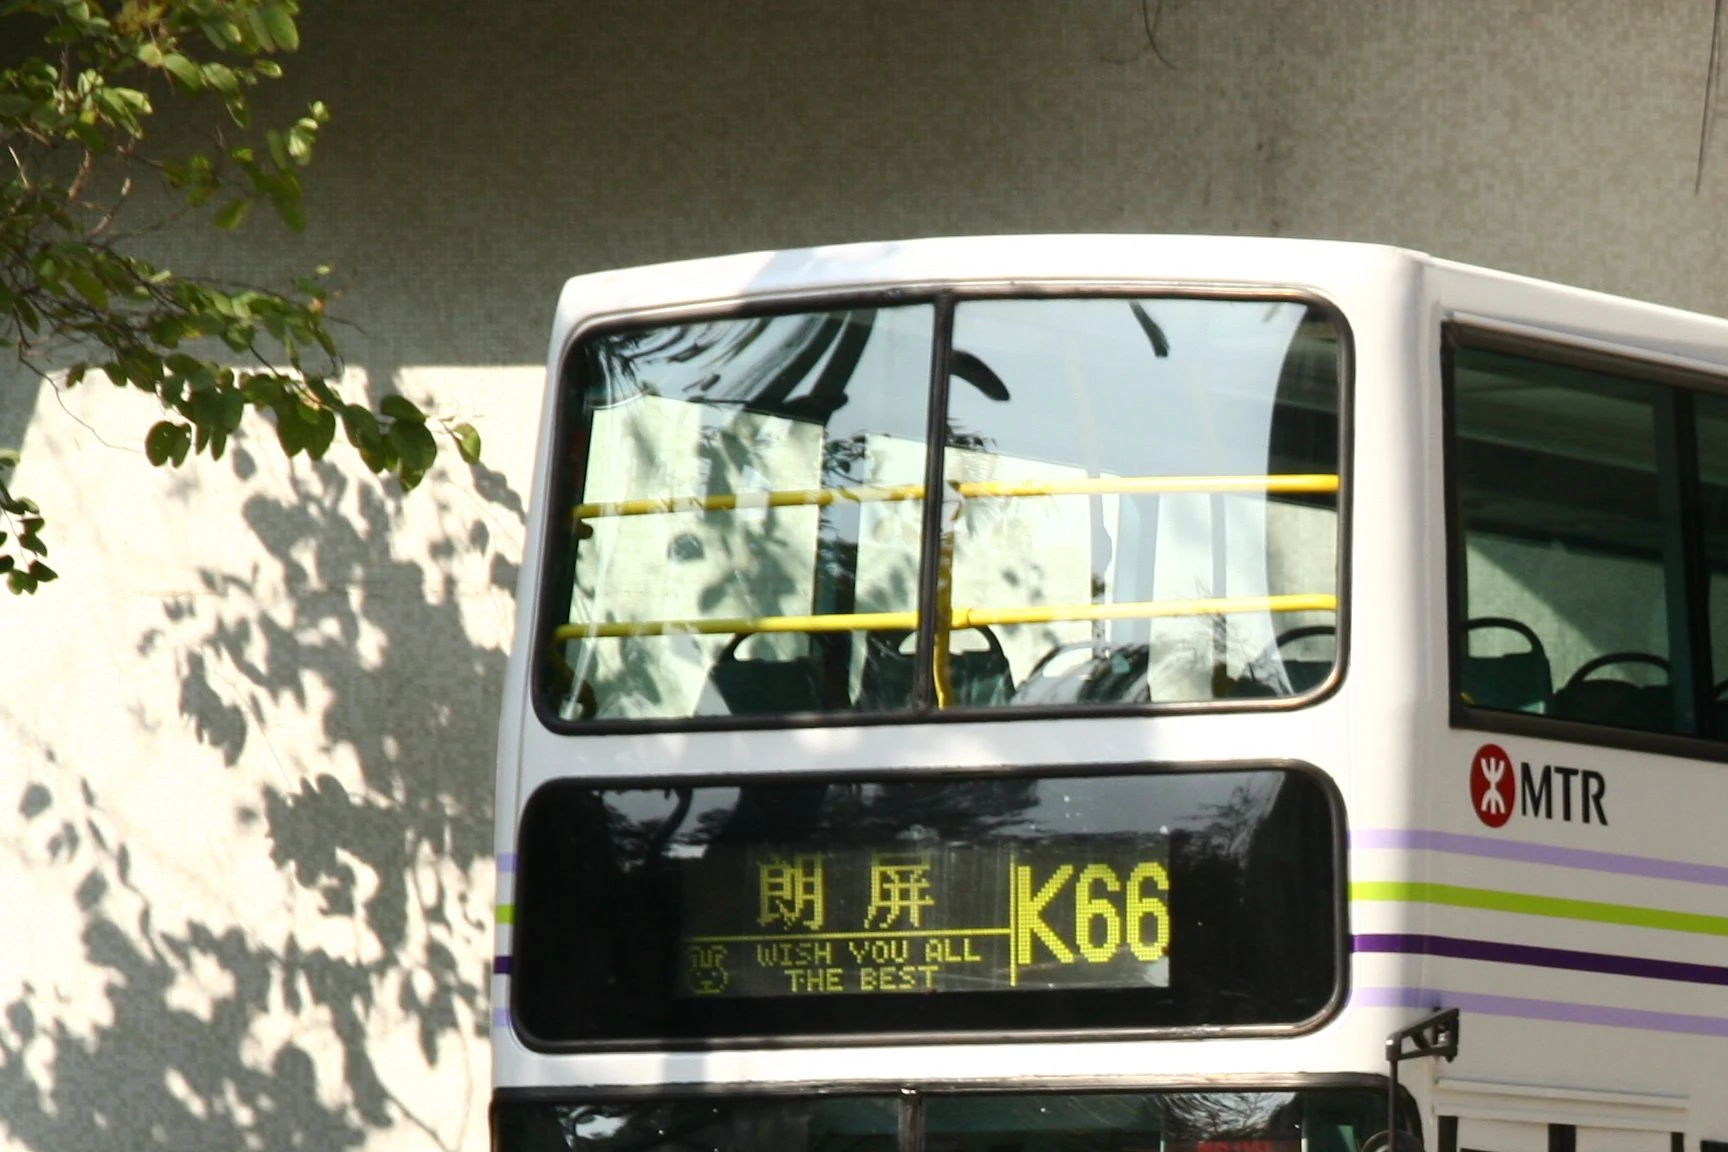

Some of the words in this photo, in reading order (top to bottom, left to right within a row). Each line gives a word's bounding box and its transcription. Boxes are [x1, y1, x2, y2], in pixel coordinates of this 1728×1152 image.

[1520, 761, 1609, 827] MTR
[756, 850, 936, 930] 朗屏
[1016, 861, 1171, 965] K66
[756, 942, 833, 968] WISH
[848, 940, 910, 965] YOU
[924, 937, 983, 963] ALL
[784, 968, 844, 993] THE
[859, 966, 940, 992] BEST
